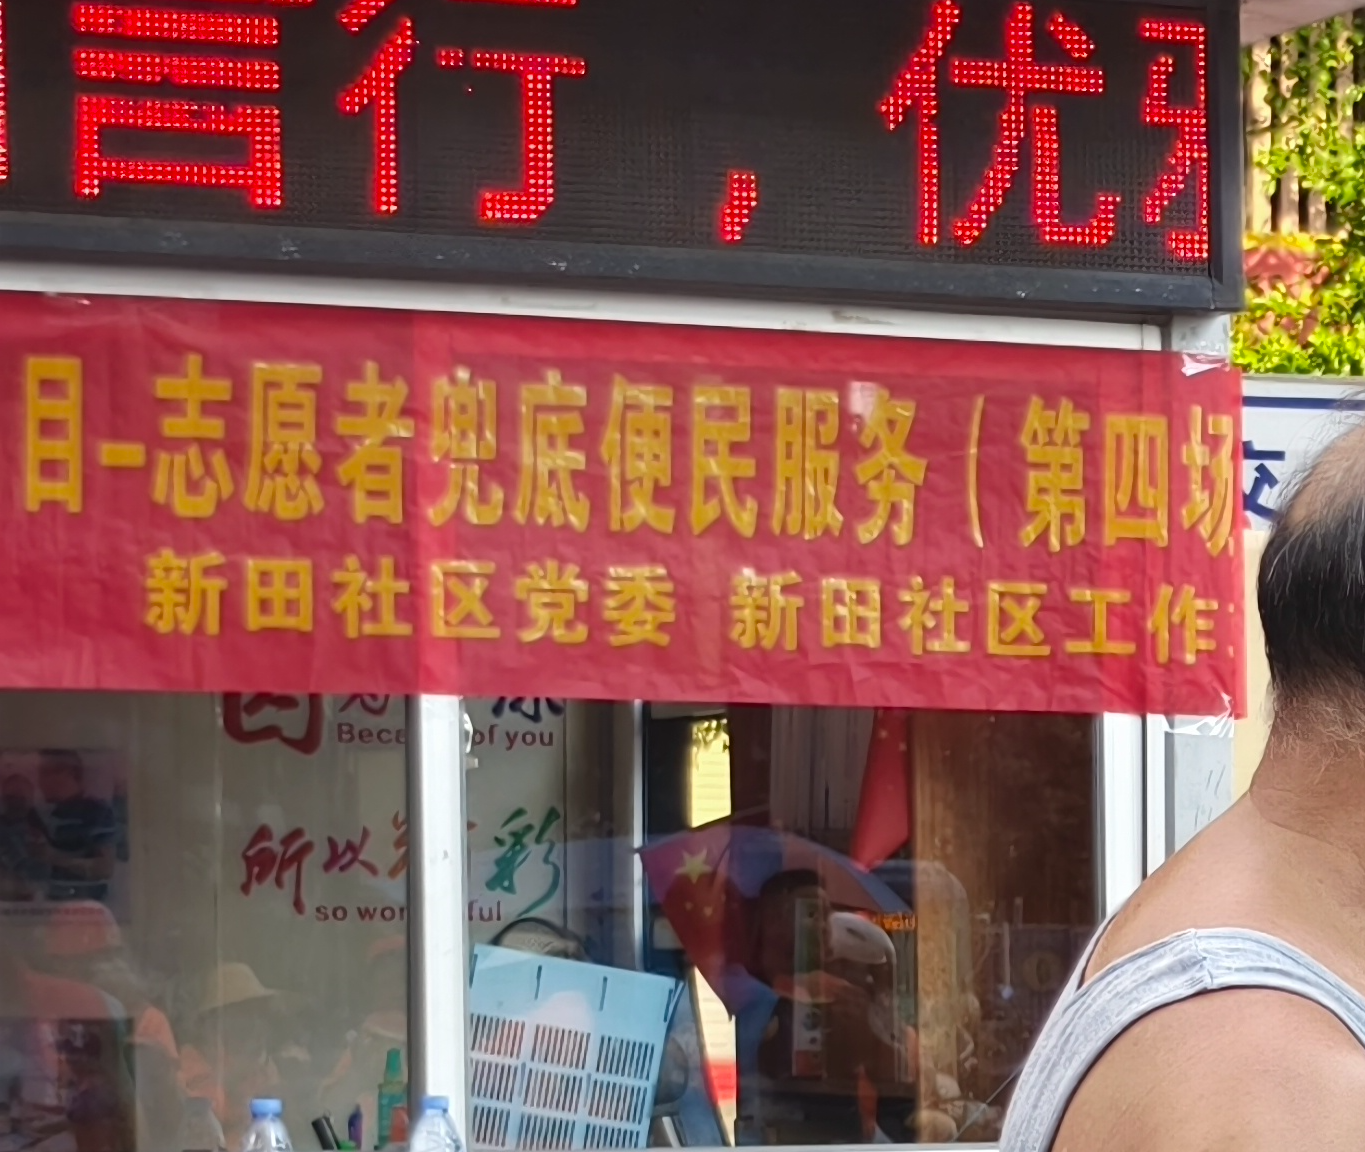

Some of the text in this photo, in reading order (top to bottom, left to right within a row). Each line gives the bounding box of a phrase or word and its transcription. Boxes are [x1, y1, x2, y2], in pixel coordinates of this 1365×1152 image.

[0, 0, 1208, 262] 言行，优
[147, 551, 675, 647] 新田社区党委
[505, 730, 554, 750] you
[240, 806, 561, 916] 所以彩
[315, 905, 348, 922] so
